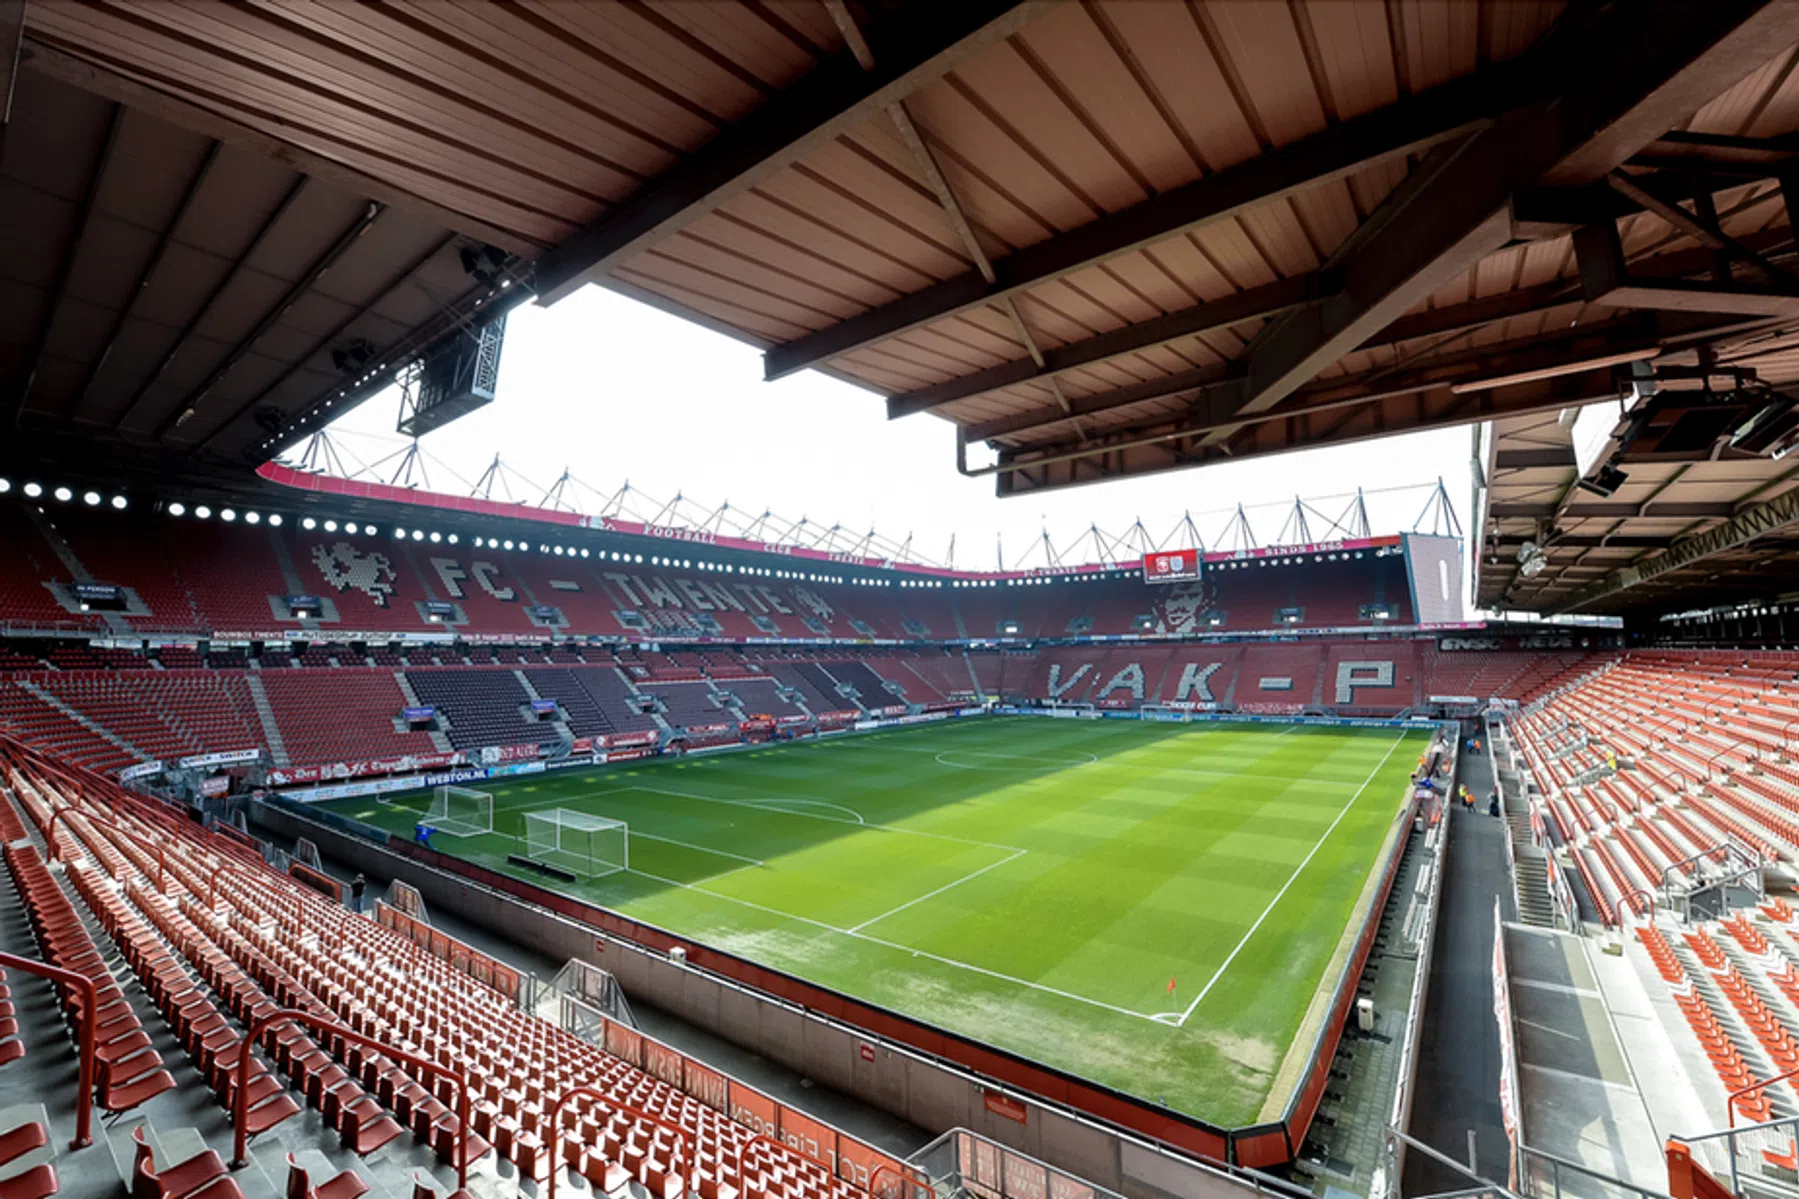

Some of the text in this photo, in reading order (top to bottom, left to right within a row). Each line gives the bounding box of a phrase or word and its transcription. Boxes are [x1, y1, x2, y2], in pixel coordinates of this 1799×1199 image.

[644, 522, 716, 545] FOOTBALL
[764, 543, 792, 555] CLUB
[1265, 545, 1306, 557] SINDS
[430, 558, 514, 599] FC
[603, 572, 792, 614] TWENTE
[1048, 662, 1223, 700] VAK
[1335, 661, 1395, 703] P
[428, 769, 486, 786] WEBTON.NL
